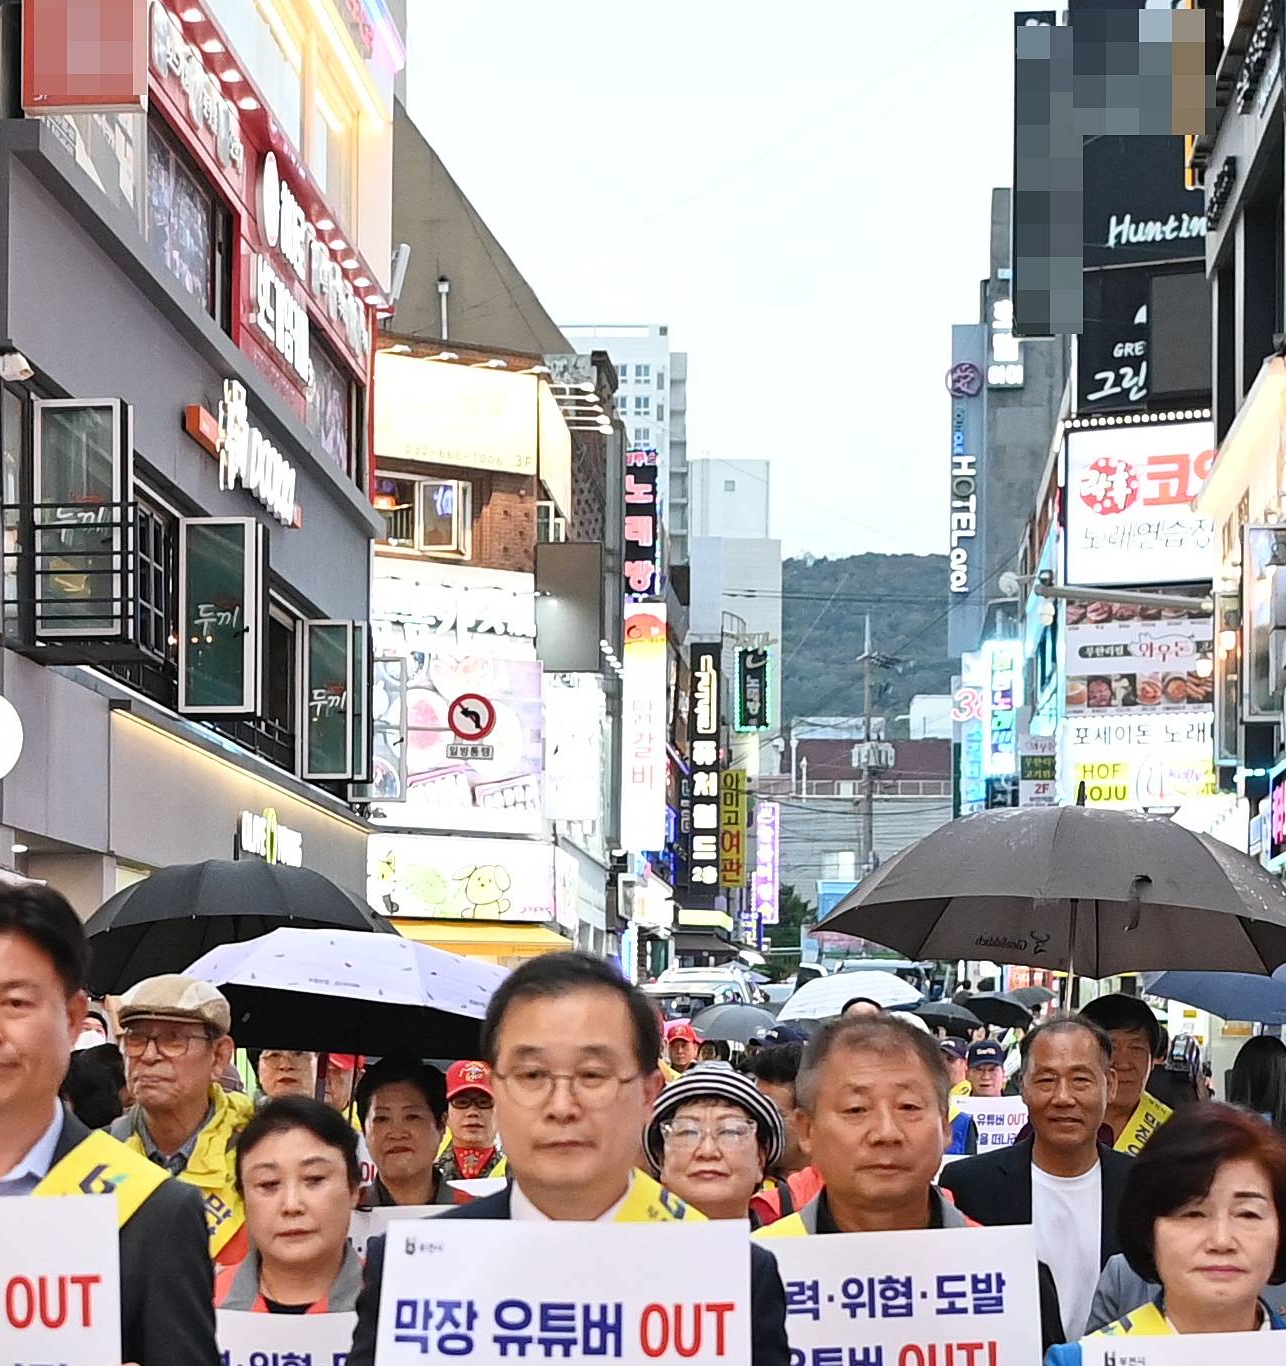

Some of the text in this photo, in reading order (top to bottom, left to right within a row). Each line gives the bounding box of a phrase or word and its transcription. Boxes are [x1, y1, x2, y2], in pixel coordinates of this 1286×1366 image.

[1113, 341, 1147, 358] GRE
[1087, 361, 1147, 401] 그린
[951, 455, 977, 547] HOTEL
[194, 603, 241, 638] 두끼
[310, 687, 348, 719] 두끼
[1073, 725, 1151, 745] 포세이돈
[1082, 763, 1122, 780] HOF
[1081, 786, 1126, 801] OJU
[5, 1274, 102, 1330] OUT
[394, 1298, 736, 1359] 막장 유튜버 OUT
